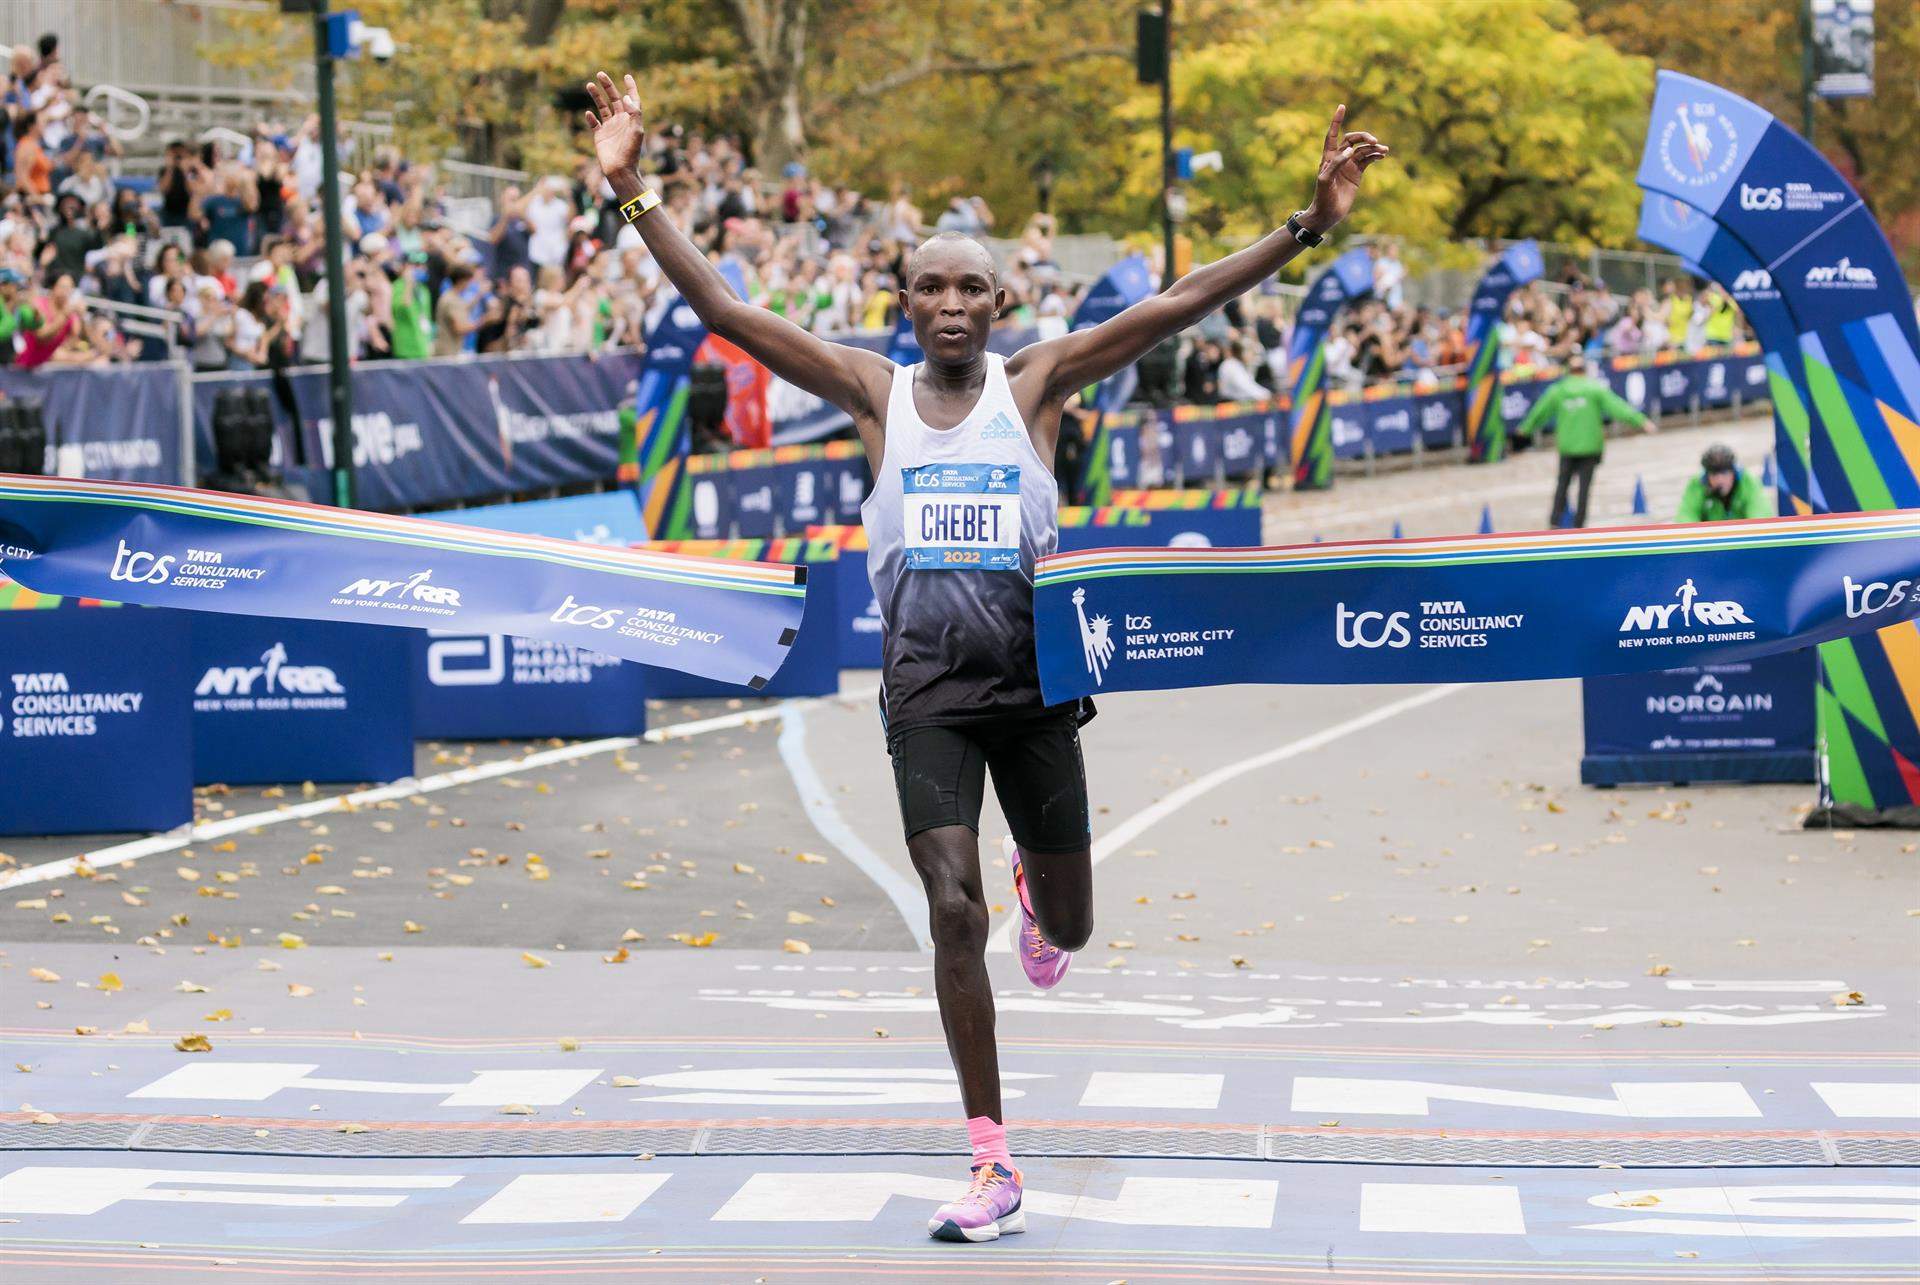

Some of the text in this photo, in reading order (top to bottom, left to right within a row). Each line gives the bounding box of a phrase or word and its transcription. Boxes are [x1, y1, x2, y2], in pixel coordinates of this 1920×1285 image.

[1740, 182, 1783, 212] tcs
[980, 428, 1022, 440] adidas
[914, 470, 940, 488] tcs
[987, 481, 1007, 489] TATA
[921, 503, 1002, 542] CHEBET
[6, 545, 34, 560] CITY
[110, 539, 176, 584] tcs
[186, 549, 222, 563] TATA
[943, 550, 981, 563] 2022
[179, 563, 266, 580] CONSULTANCY
[170, 576, 227, 589] SERVICES
[1843, 575, 1912, 618] tcs
[329, 597, 457, 616] NEW YORK ROAD RUNNERS
[549, 594, 624, 630] tcs
[635, 607, 676, 623] TATA
[1419, 600, 1466, 615] TATA
[1619, 600, 1755, 631] NYRR
[626, 616, 725, 645] CONSULTANCY
[1125, 613, 1152, 631] tcs
[1336, 602, 1412, 649] tcs
[1419, 614, 1524, 632] CONSULTANCY
[616, 625, 681, 647] SERVICES
[1126, 629, 1235, 646] NEW YORK CITY
[1419, 633, 1488, 649] SERVICES
[1618, 631, 1756, 648] NEW YORK ROAD RUNNERS
[1126, 645, 1204, 660] MARATHON
[11, 672, 70, 693] TATA
[512, 666, 592, 684] MAJORS
[11, 692, 143, 715] CONSULTANCY
[12, 714, 98, 737] SERVICES
